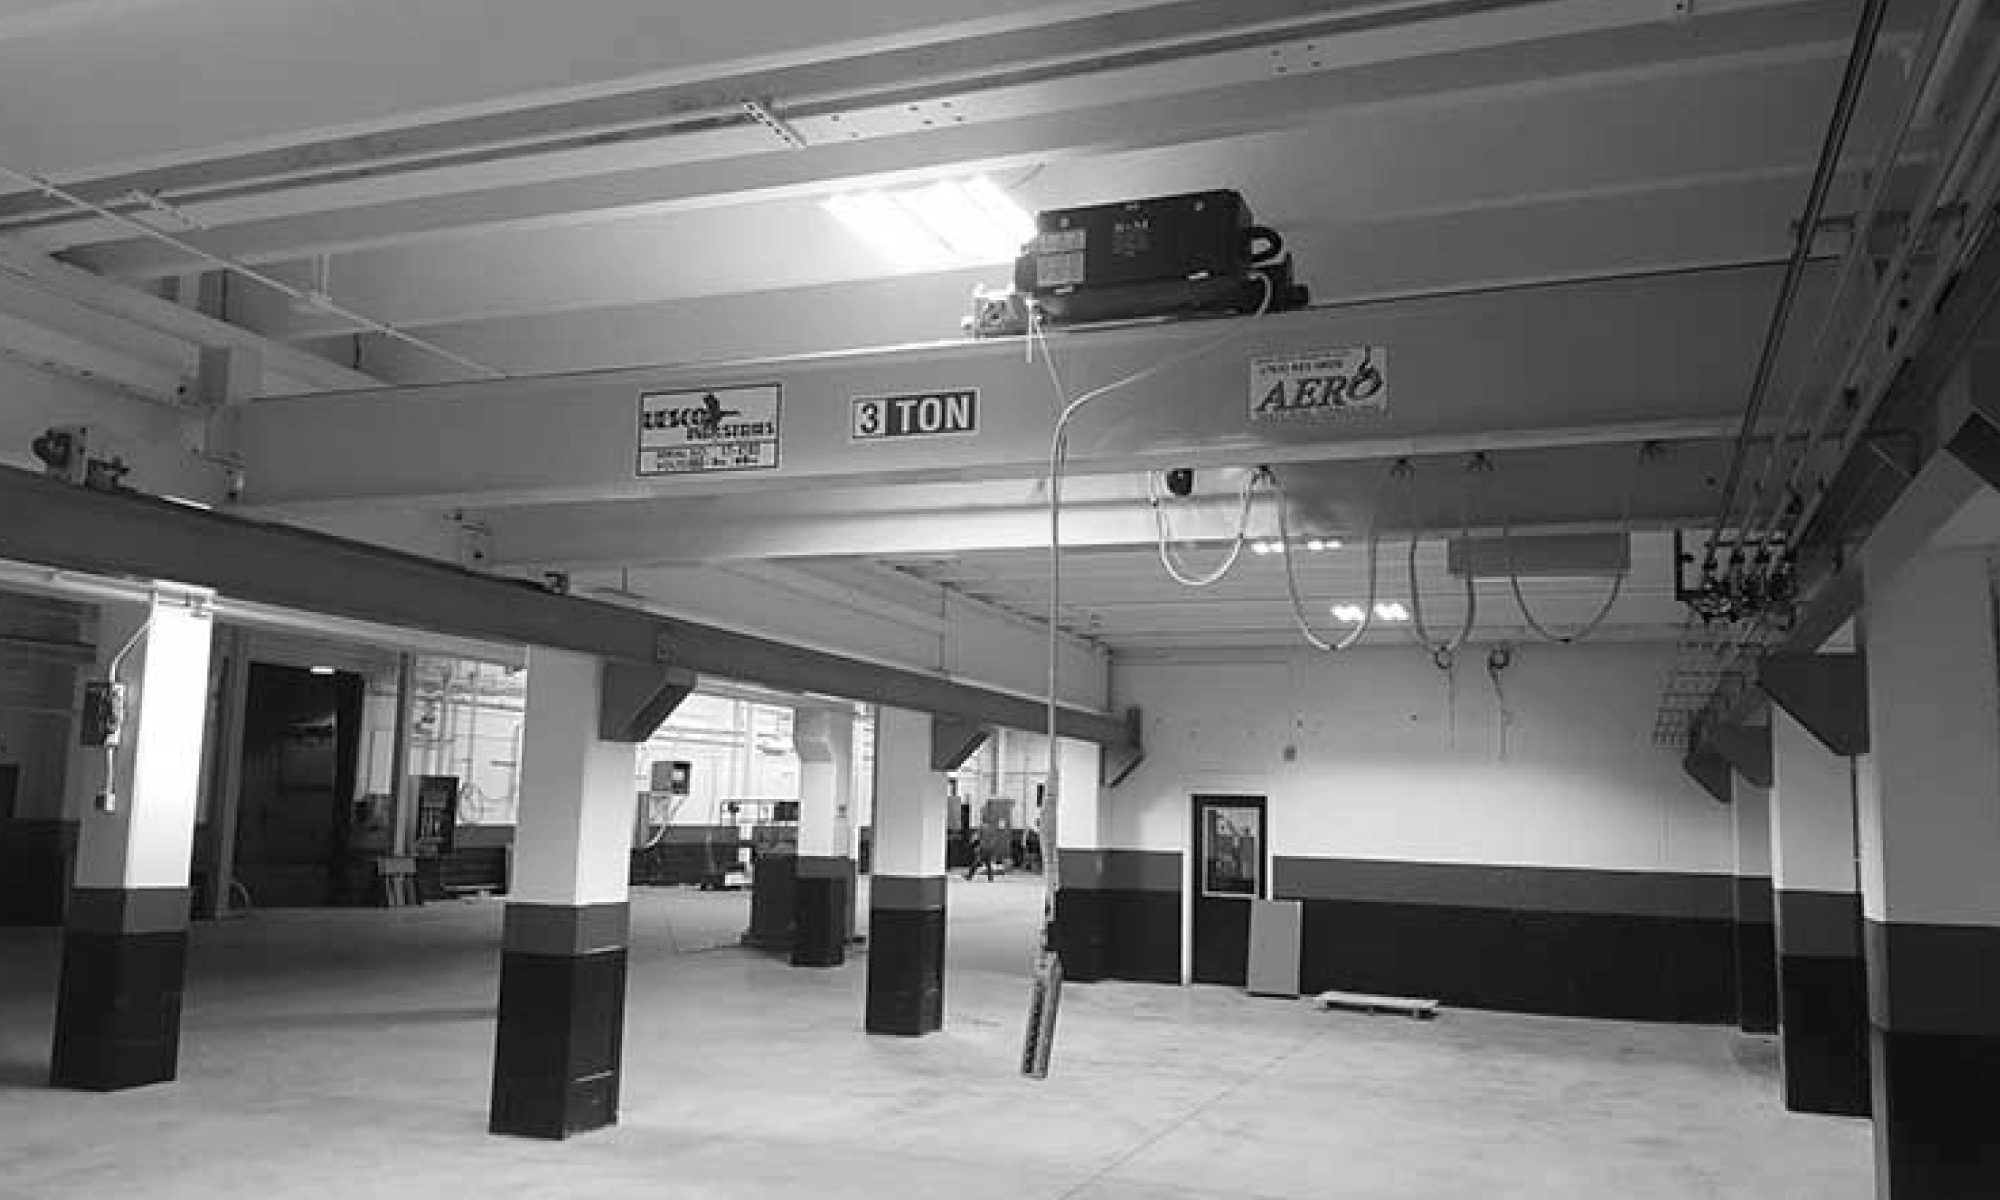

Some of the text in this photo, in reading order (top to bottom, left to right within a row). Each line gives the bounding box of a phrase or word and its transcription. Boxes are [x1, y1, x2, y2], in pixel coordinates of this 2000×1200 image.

[1254, 366, 1384, 412] AERO
[640, 408, 710, 430] LESCO
[860, 396, 970, 434] 3 TON
